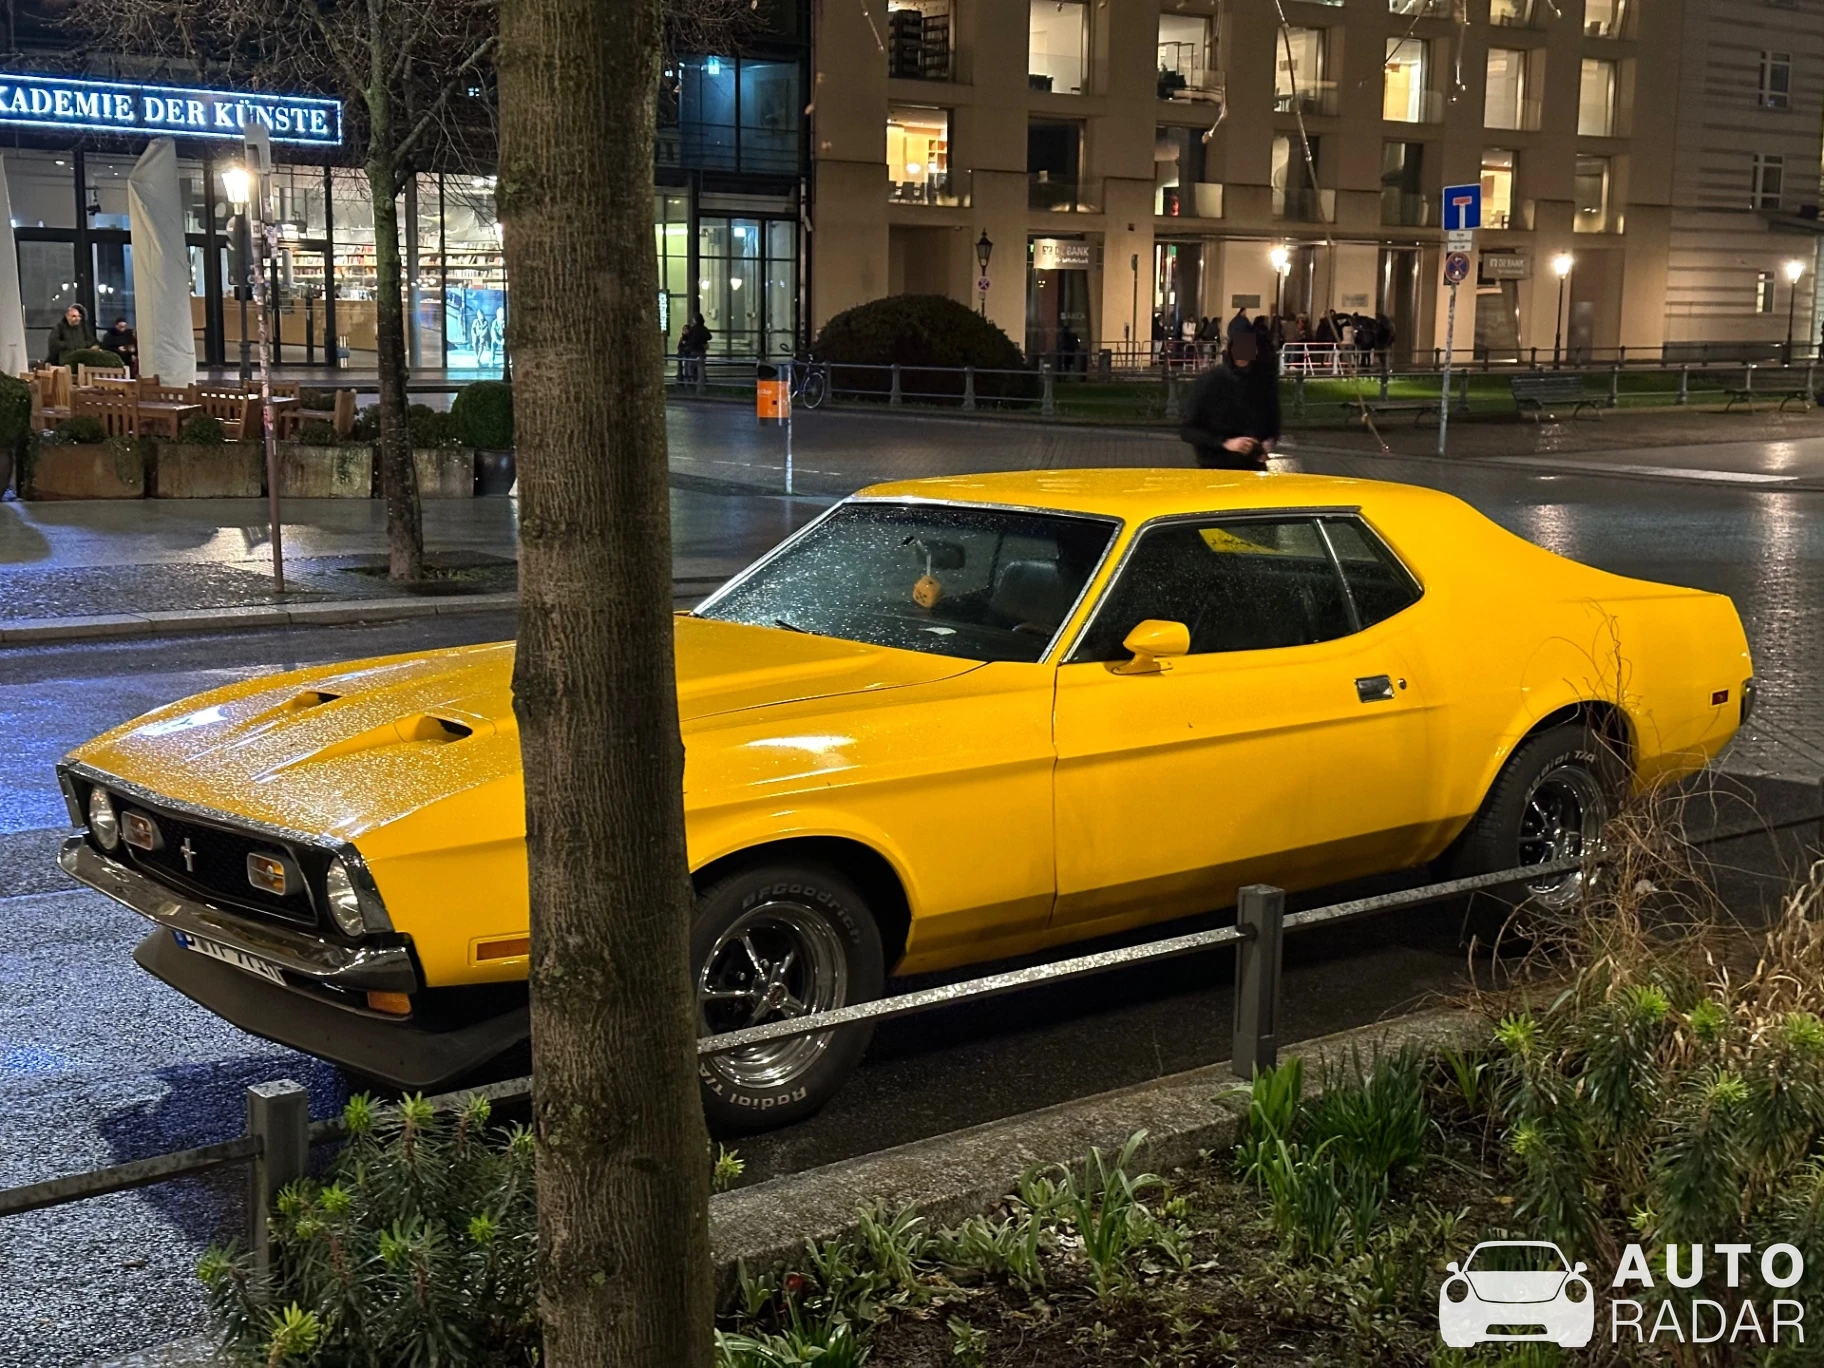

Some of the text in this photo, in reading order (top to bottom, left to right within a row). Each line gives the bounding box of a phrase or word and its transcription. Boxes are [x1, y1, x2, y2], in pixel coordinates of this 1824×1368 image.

[143, 96, 206, 126] DER
[213, 99, 329, 134] KÜNSTE
[1066, 246, 1090, 256] BANK
[1574, 749, 1596, 764] T/A
[699, 1062, 807, 1111] Radial T/A
